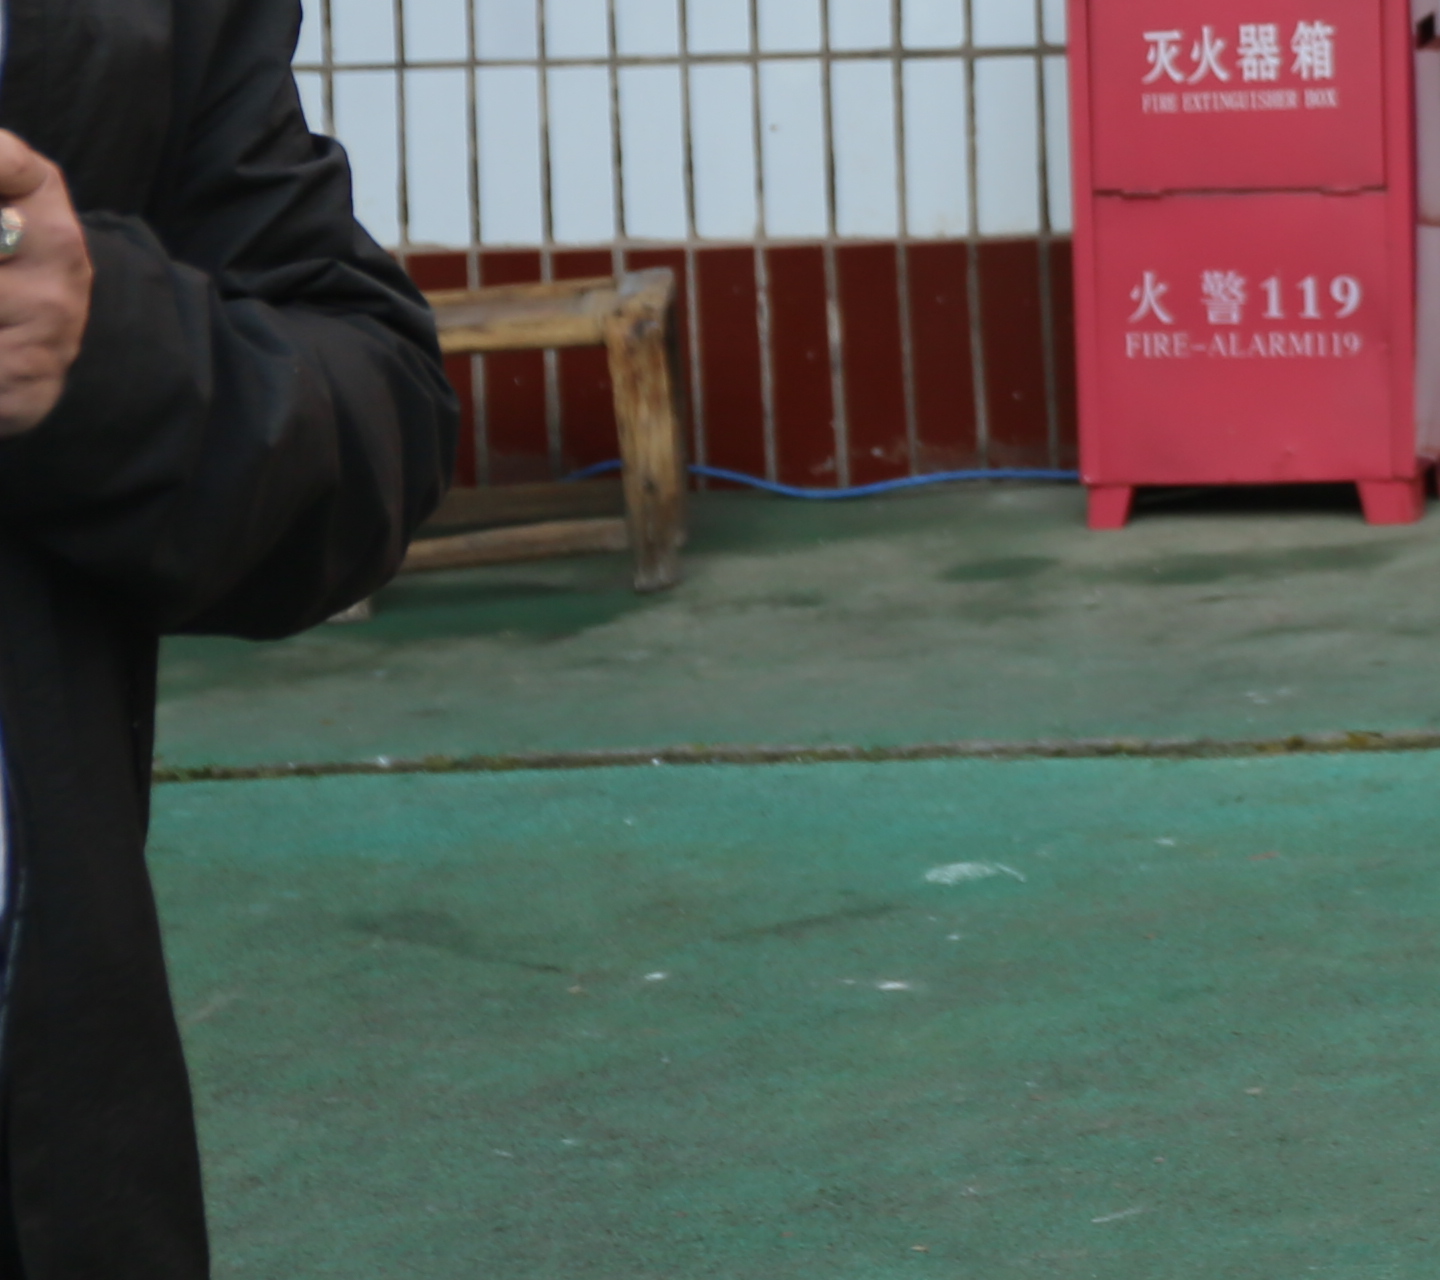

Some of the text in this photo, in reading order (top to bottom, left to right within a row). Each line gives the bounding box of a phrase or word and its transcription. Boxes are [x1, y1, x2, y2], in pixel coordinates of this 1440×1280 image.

[1141, 20, 1335, 84] 灭火器箱
[1142, 87, 1338, 114] FIRE EXTINGUISHER BOX
[1125, 332, 1361, 359] FIRE-ALARM119
